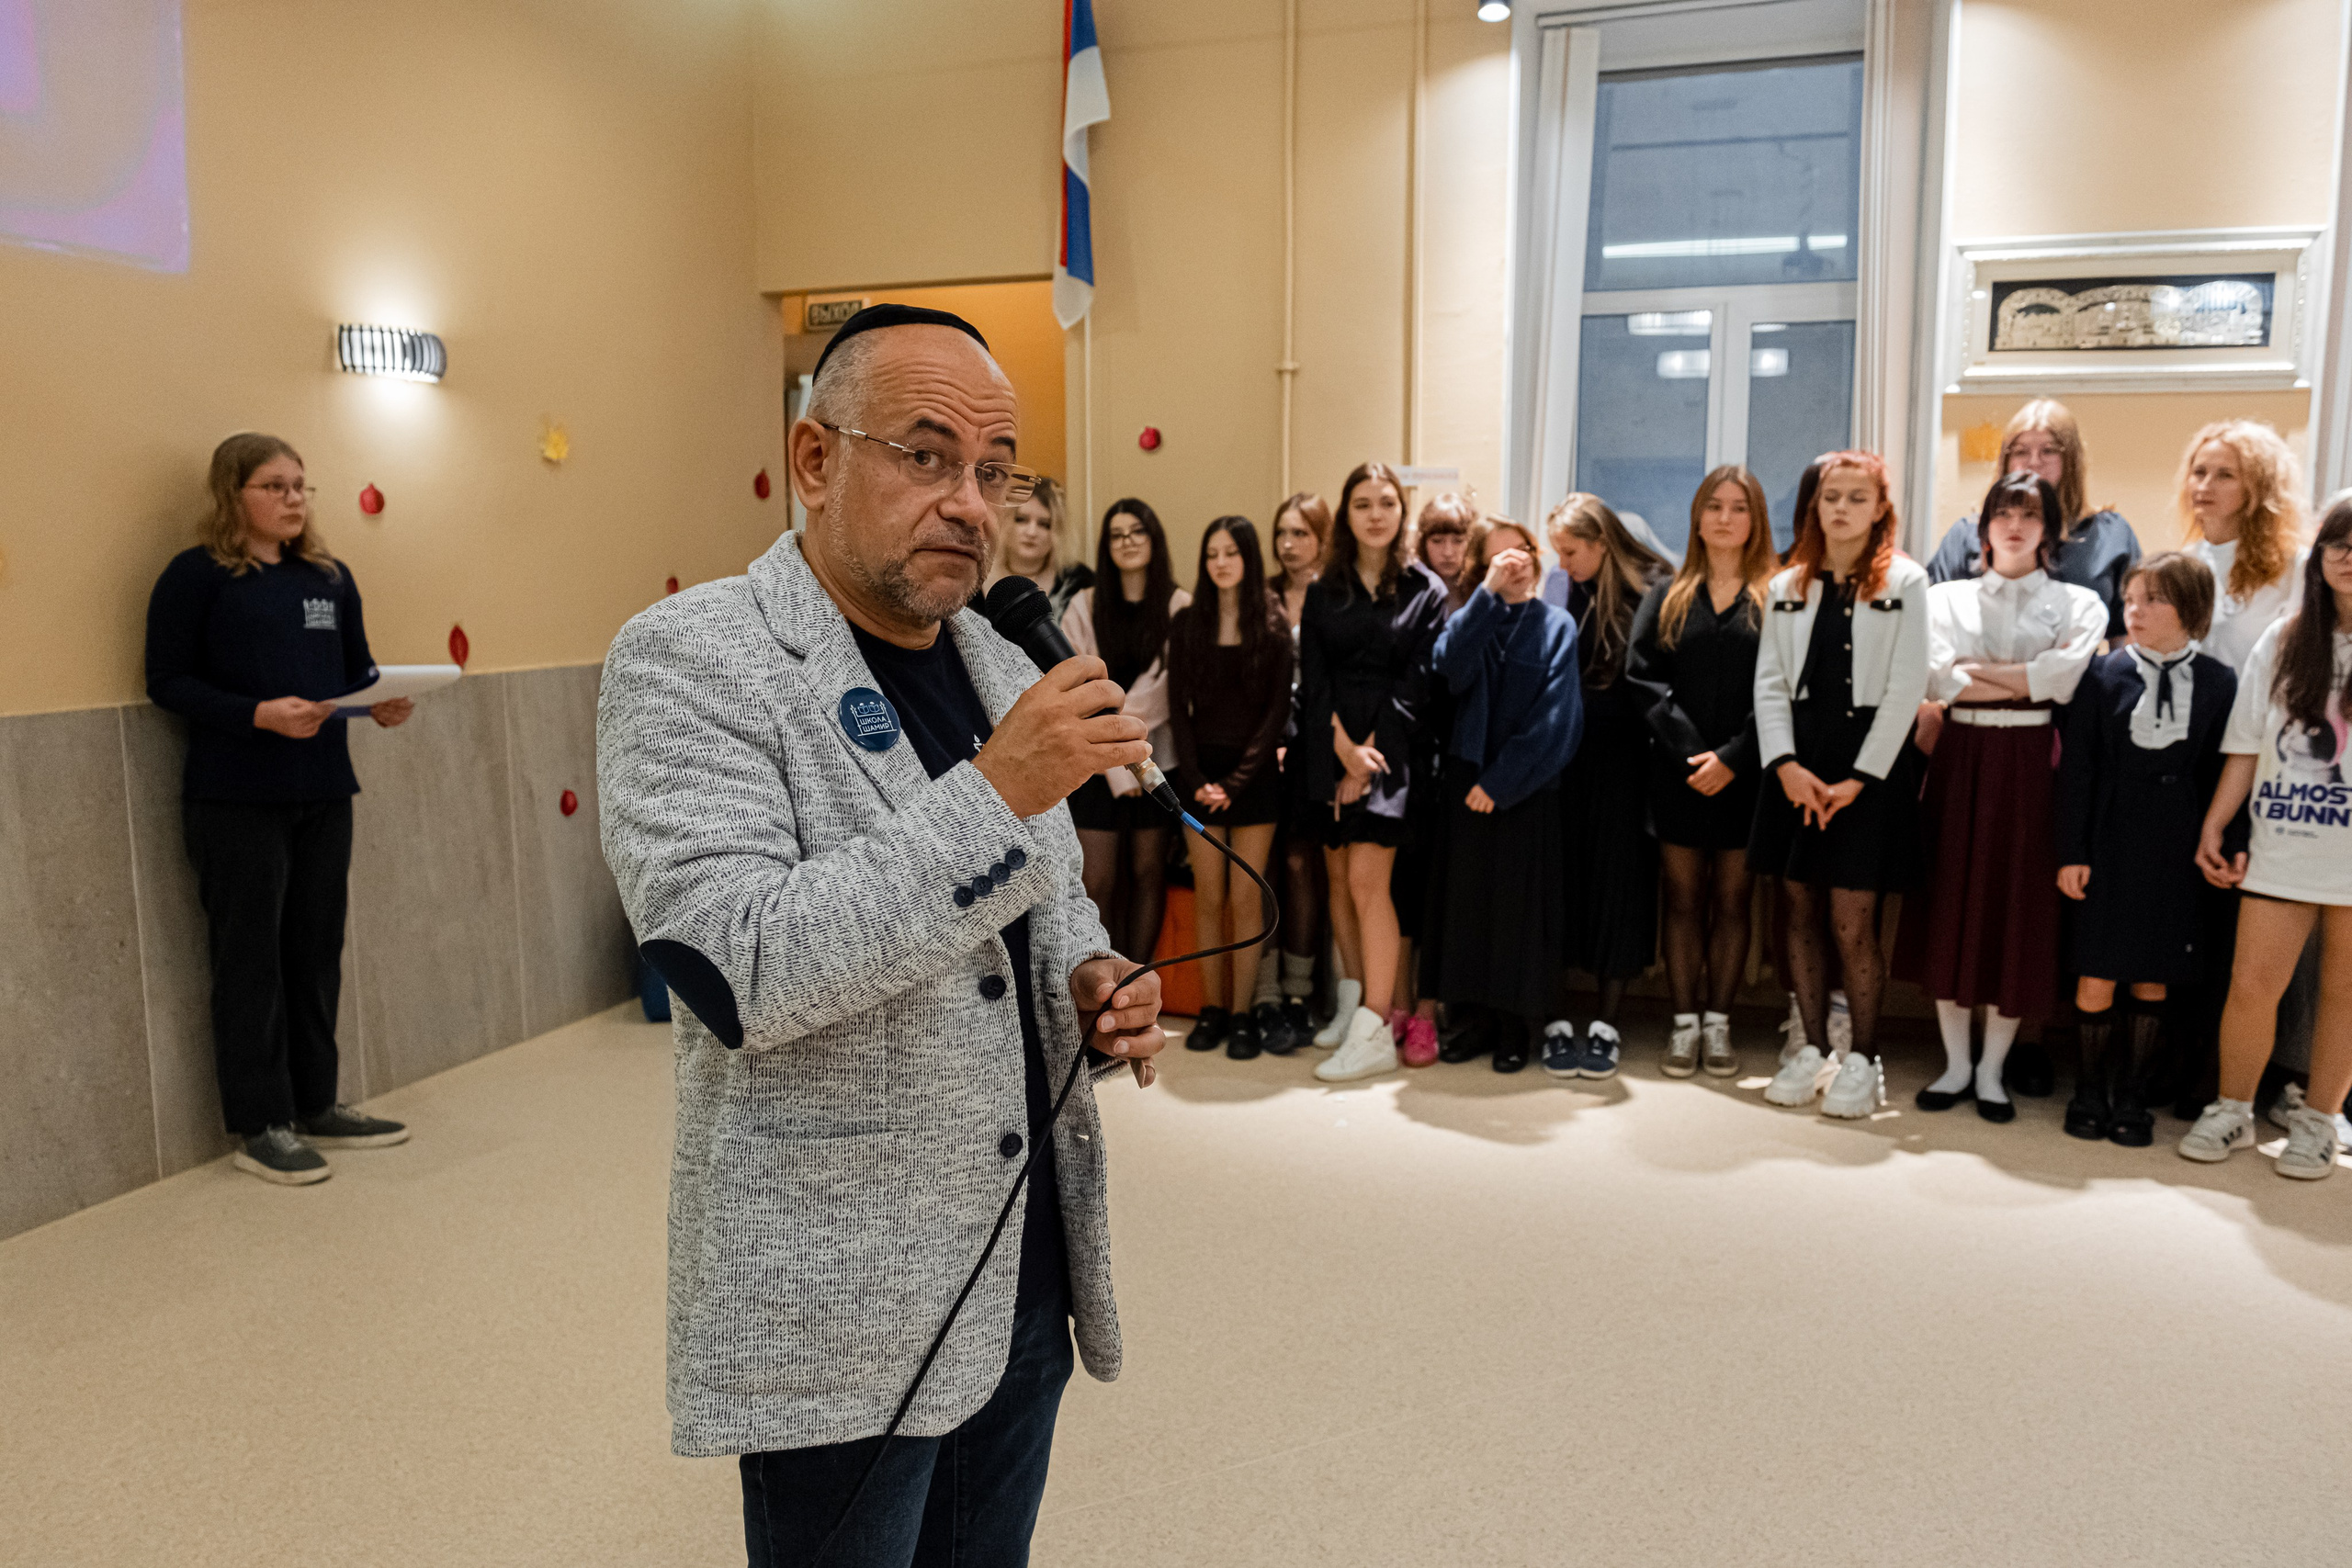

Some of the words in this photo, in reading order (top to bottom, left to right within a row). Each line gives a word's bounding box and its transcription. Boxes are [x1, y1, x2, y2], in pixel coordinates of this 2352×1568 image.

[859, 716, 887, 726] ШКОЛА
[862, 723, 890, 733] ШАМИР
[2258, 781, 2352, 805] ALMOS
[2267, 803, 2352, 827] BUNN
